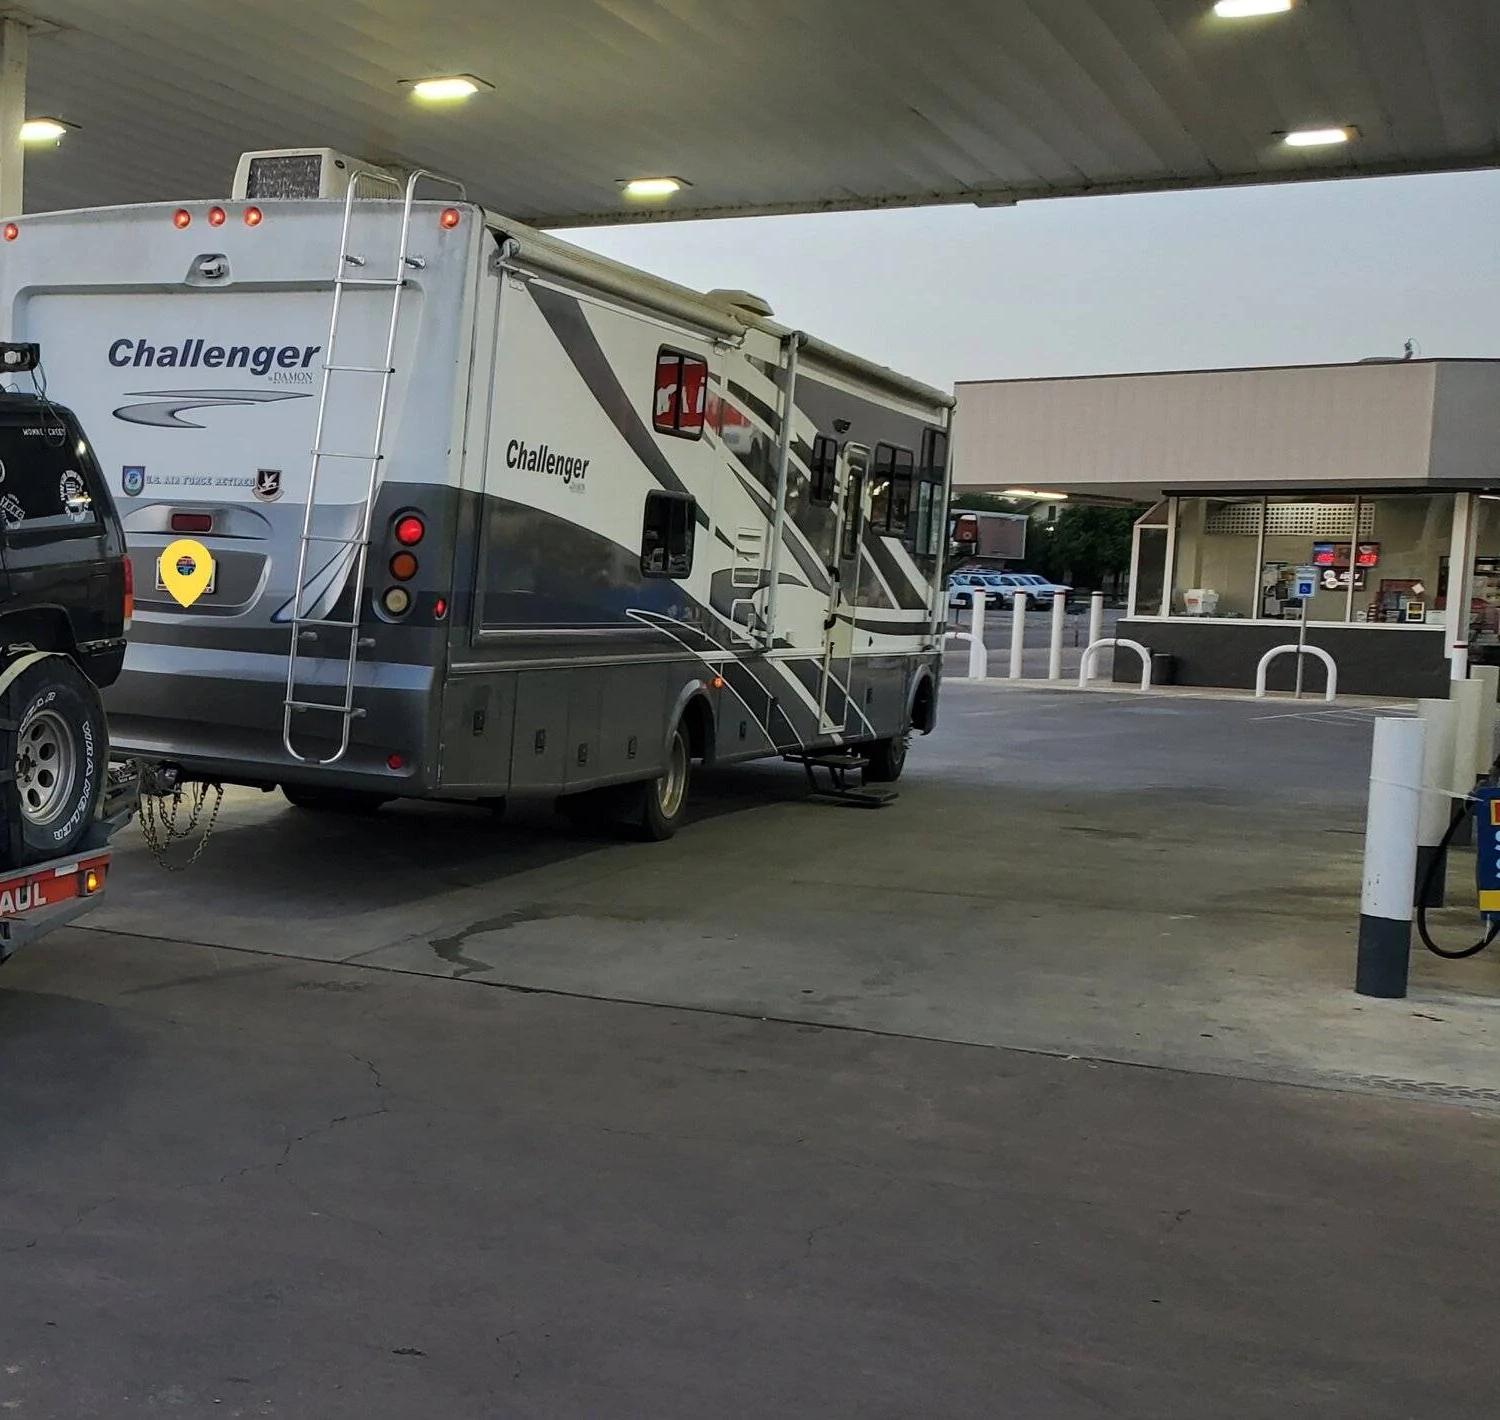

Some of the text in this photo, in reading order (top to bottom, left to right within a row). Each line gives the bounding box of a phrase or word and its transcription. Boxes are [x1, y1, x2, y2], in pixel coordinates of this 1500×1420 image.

[108, 339, 321, 376] Challenger
[273, 371, 314, 381] DAMON
[506, 439, 590, 484] Challenger
[182, 476, 212, 486] FORCE
[215, 477, 256, 487] RETIRED
[52, 720, 94, 841] WRANGLER
